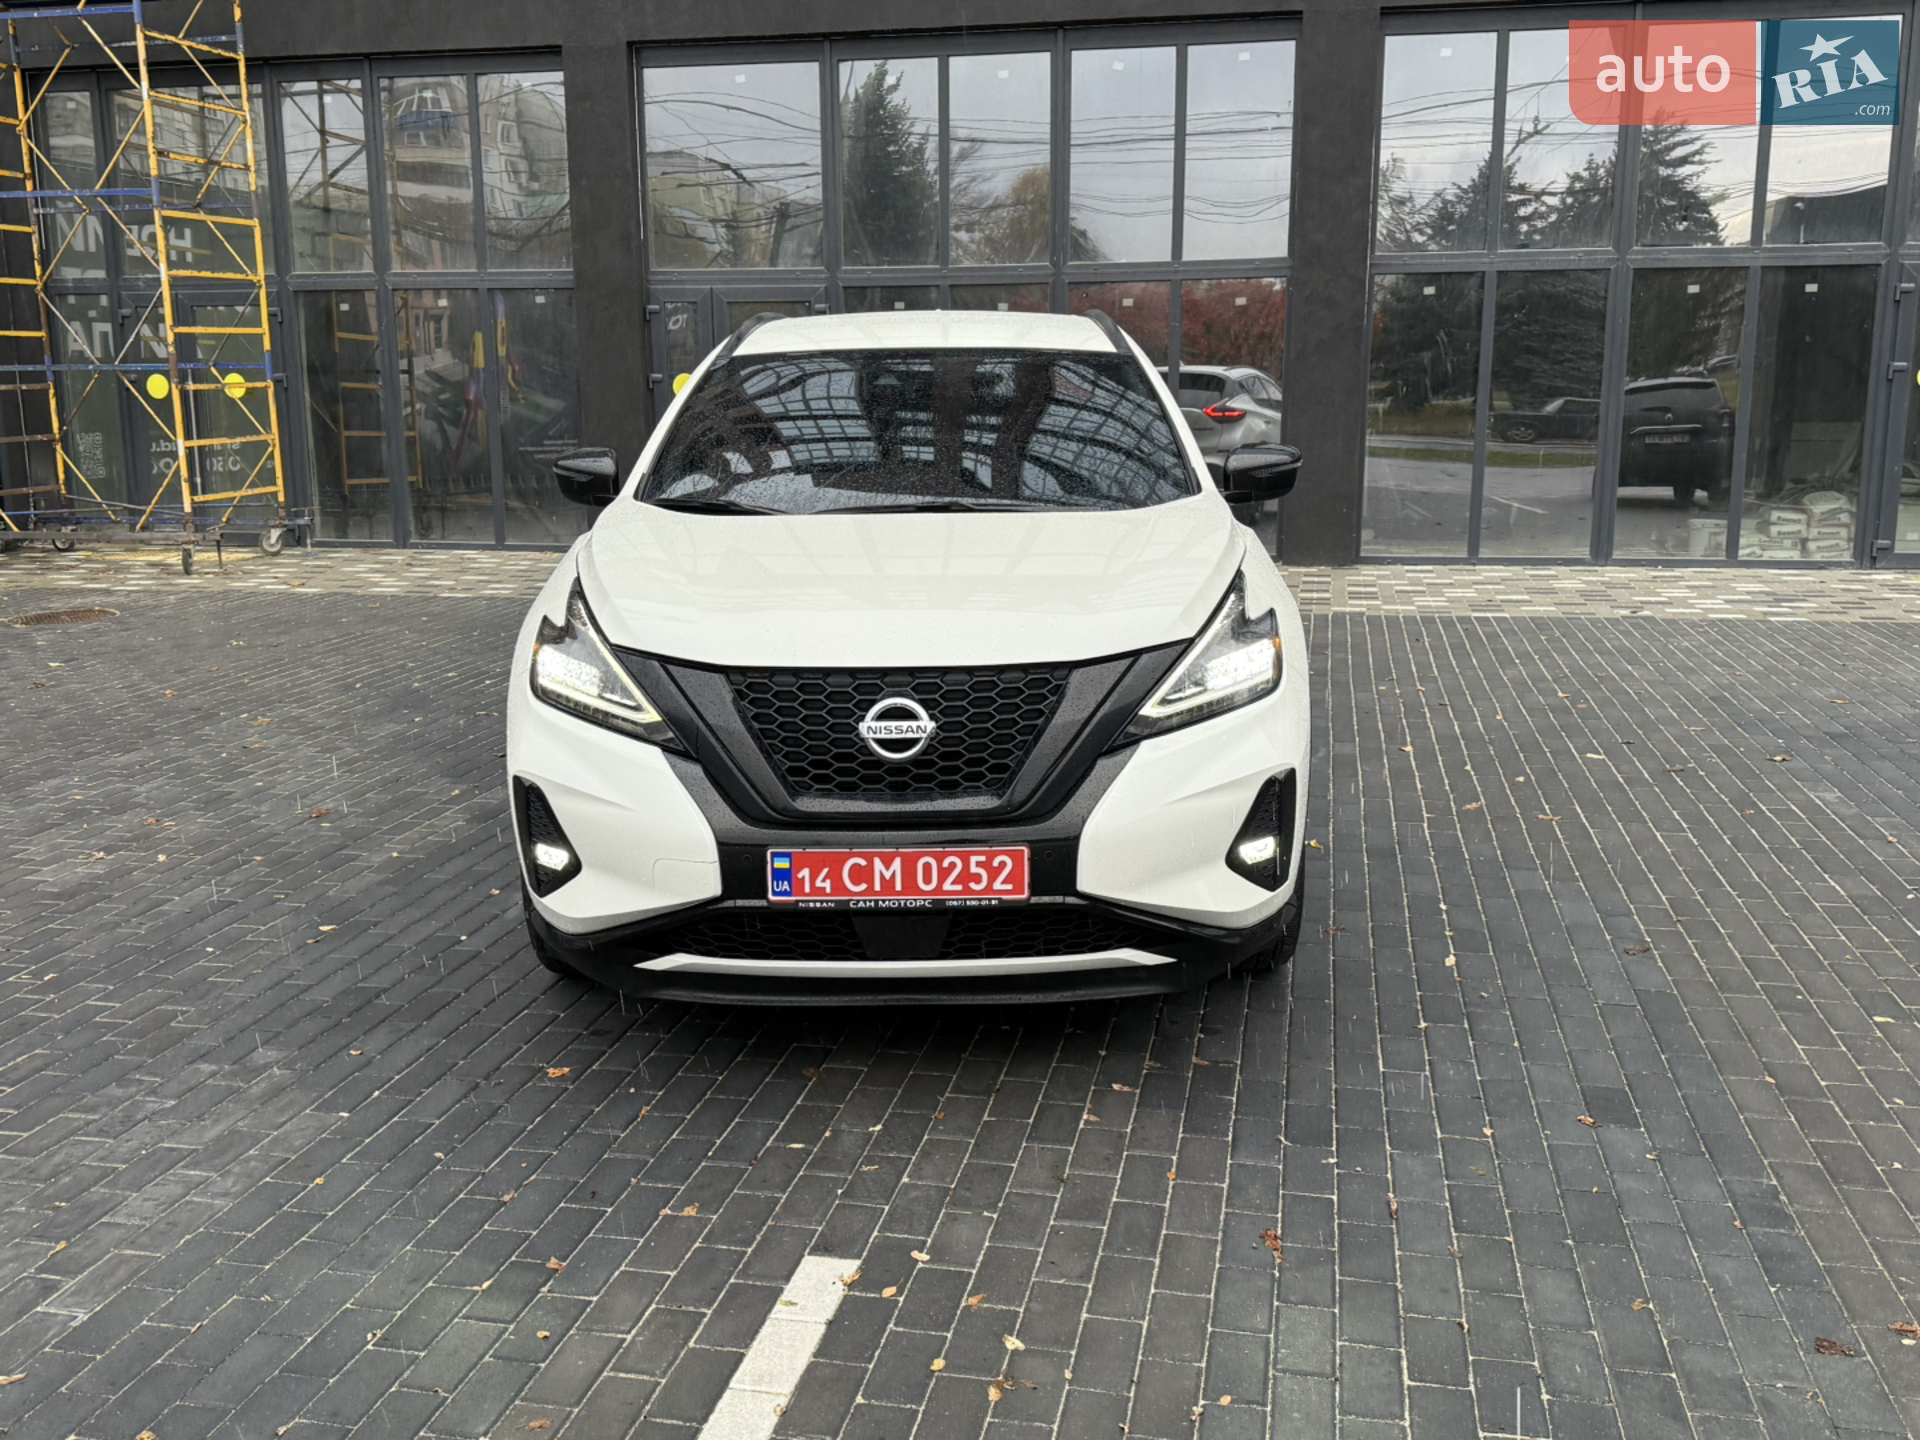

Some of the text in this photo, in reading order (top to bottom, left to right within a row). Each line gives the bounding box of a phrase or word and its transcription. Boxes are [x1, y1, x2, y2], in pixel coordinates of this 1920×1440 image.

[866, 724, 928, 736] NISSAN
[796, 855, 1013, 894] 14 CM 0252
[773, 880, 791, 893] UA
